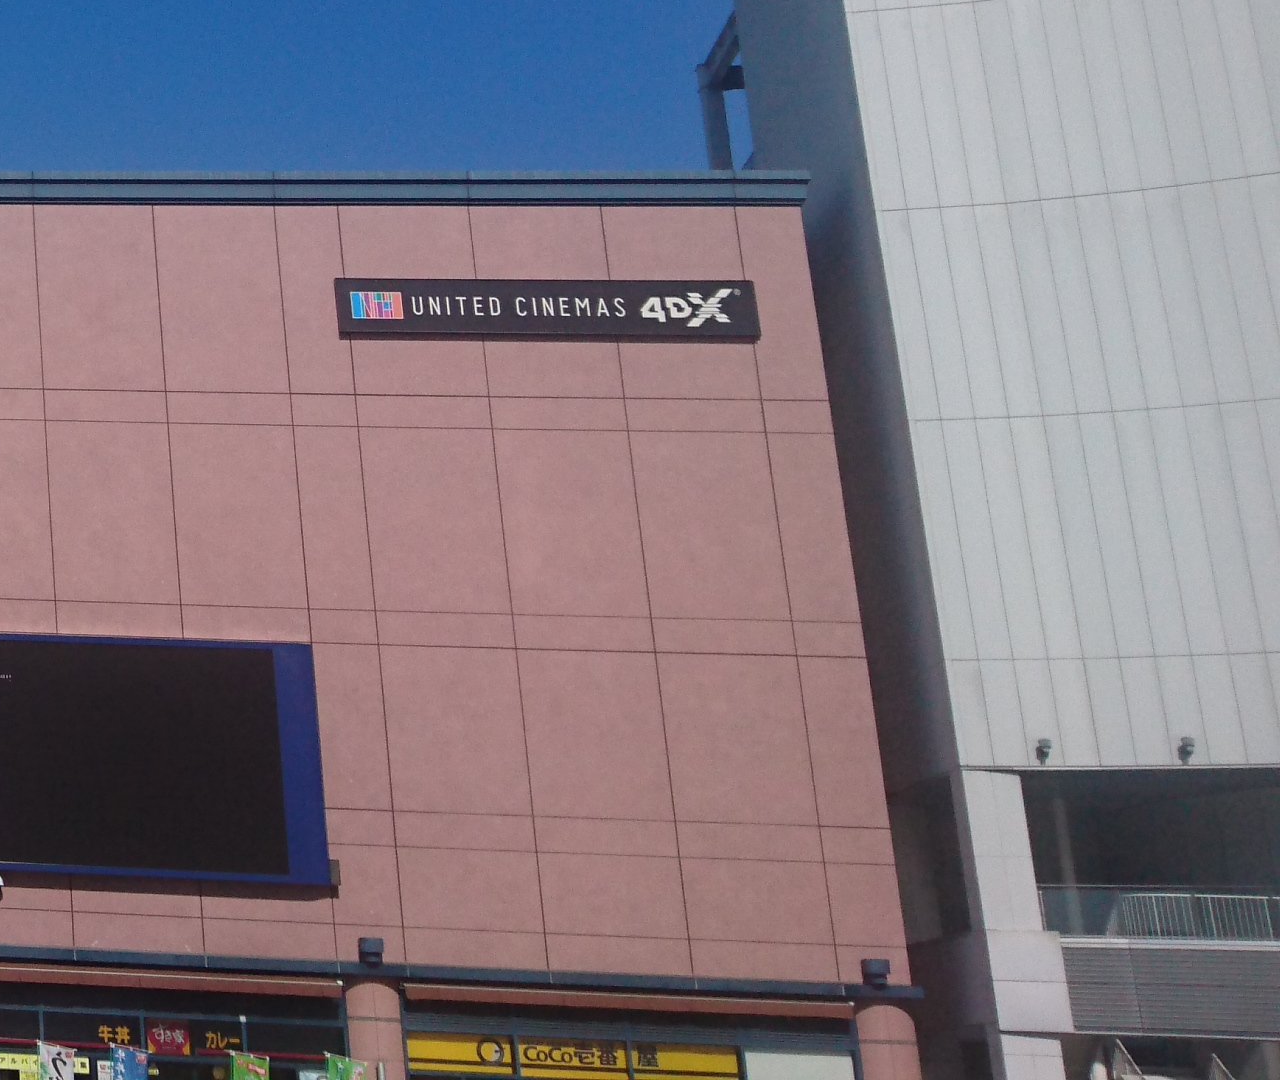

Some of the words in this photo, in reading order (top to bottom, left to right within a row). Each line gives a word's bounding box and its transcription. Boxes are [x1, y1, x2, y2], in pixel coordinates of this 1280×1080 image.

[412, 296, 502, 317] UNITED
[515, 296, 627, 319] CINEMAS
[640, 288, 733, 328] 4DX
[98, 1024, 131, 1045] 牛丼
[152, 1023, 185, 1044] すき家
[205, 1031, 241, 1049] カレー
